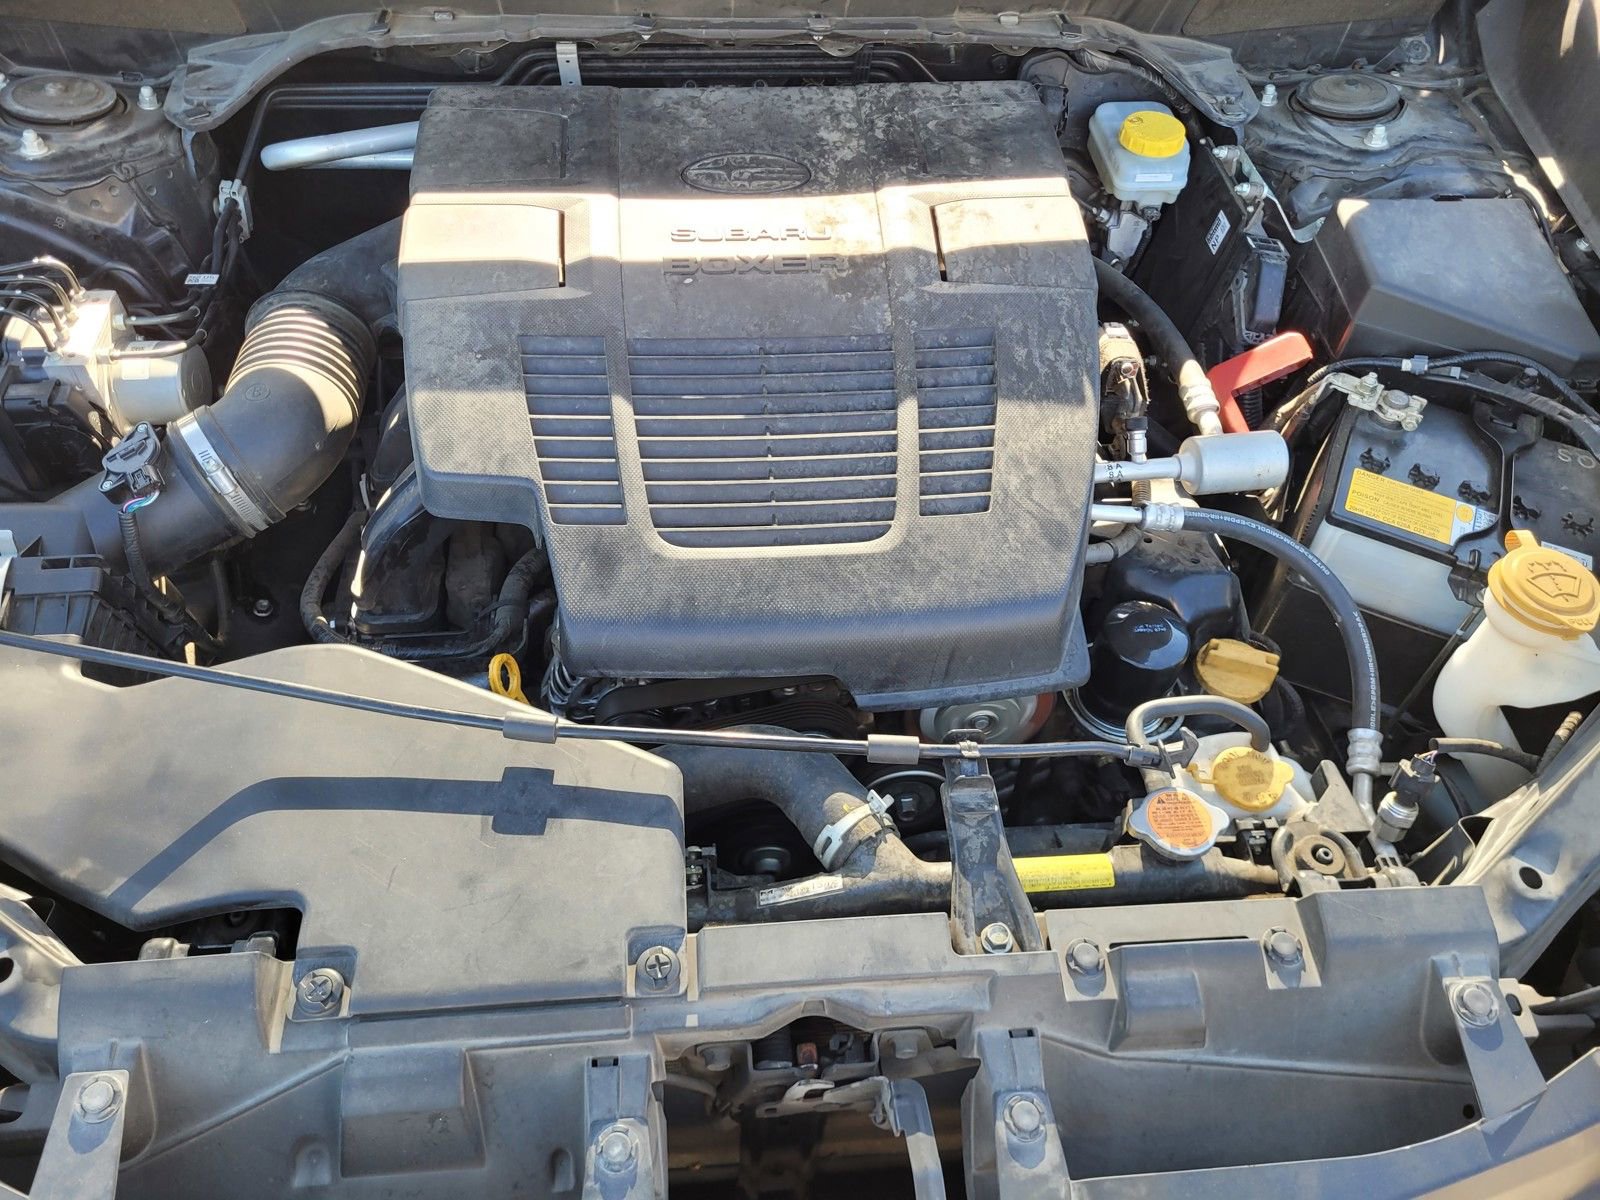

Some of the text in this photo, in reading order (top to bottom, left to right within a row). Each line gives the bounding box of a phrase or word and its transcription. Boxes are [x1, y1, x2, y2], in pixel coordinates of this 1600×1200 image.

[670, 227, 832, 242] SUBARU
[662, 254, 851, 276] BOXER
[1351, 489, 1380, 502] POISON
